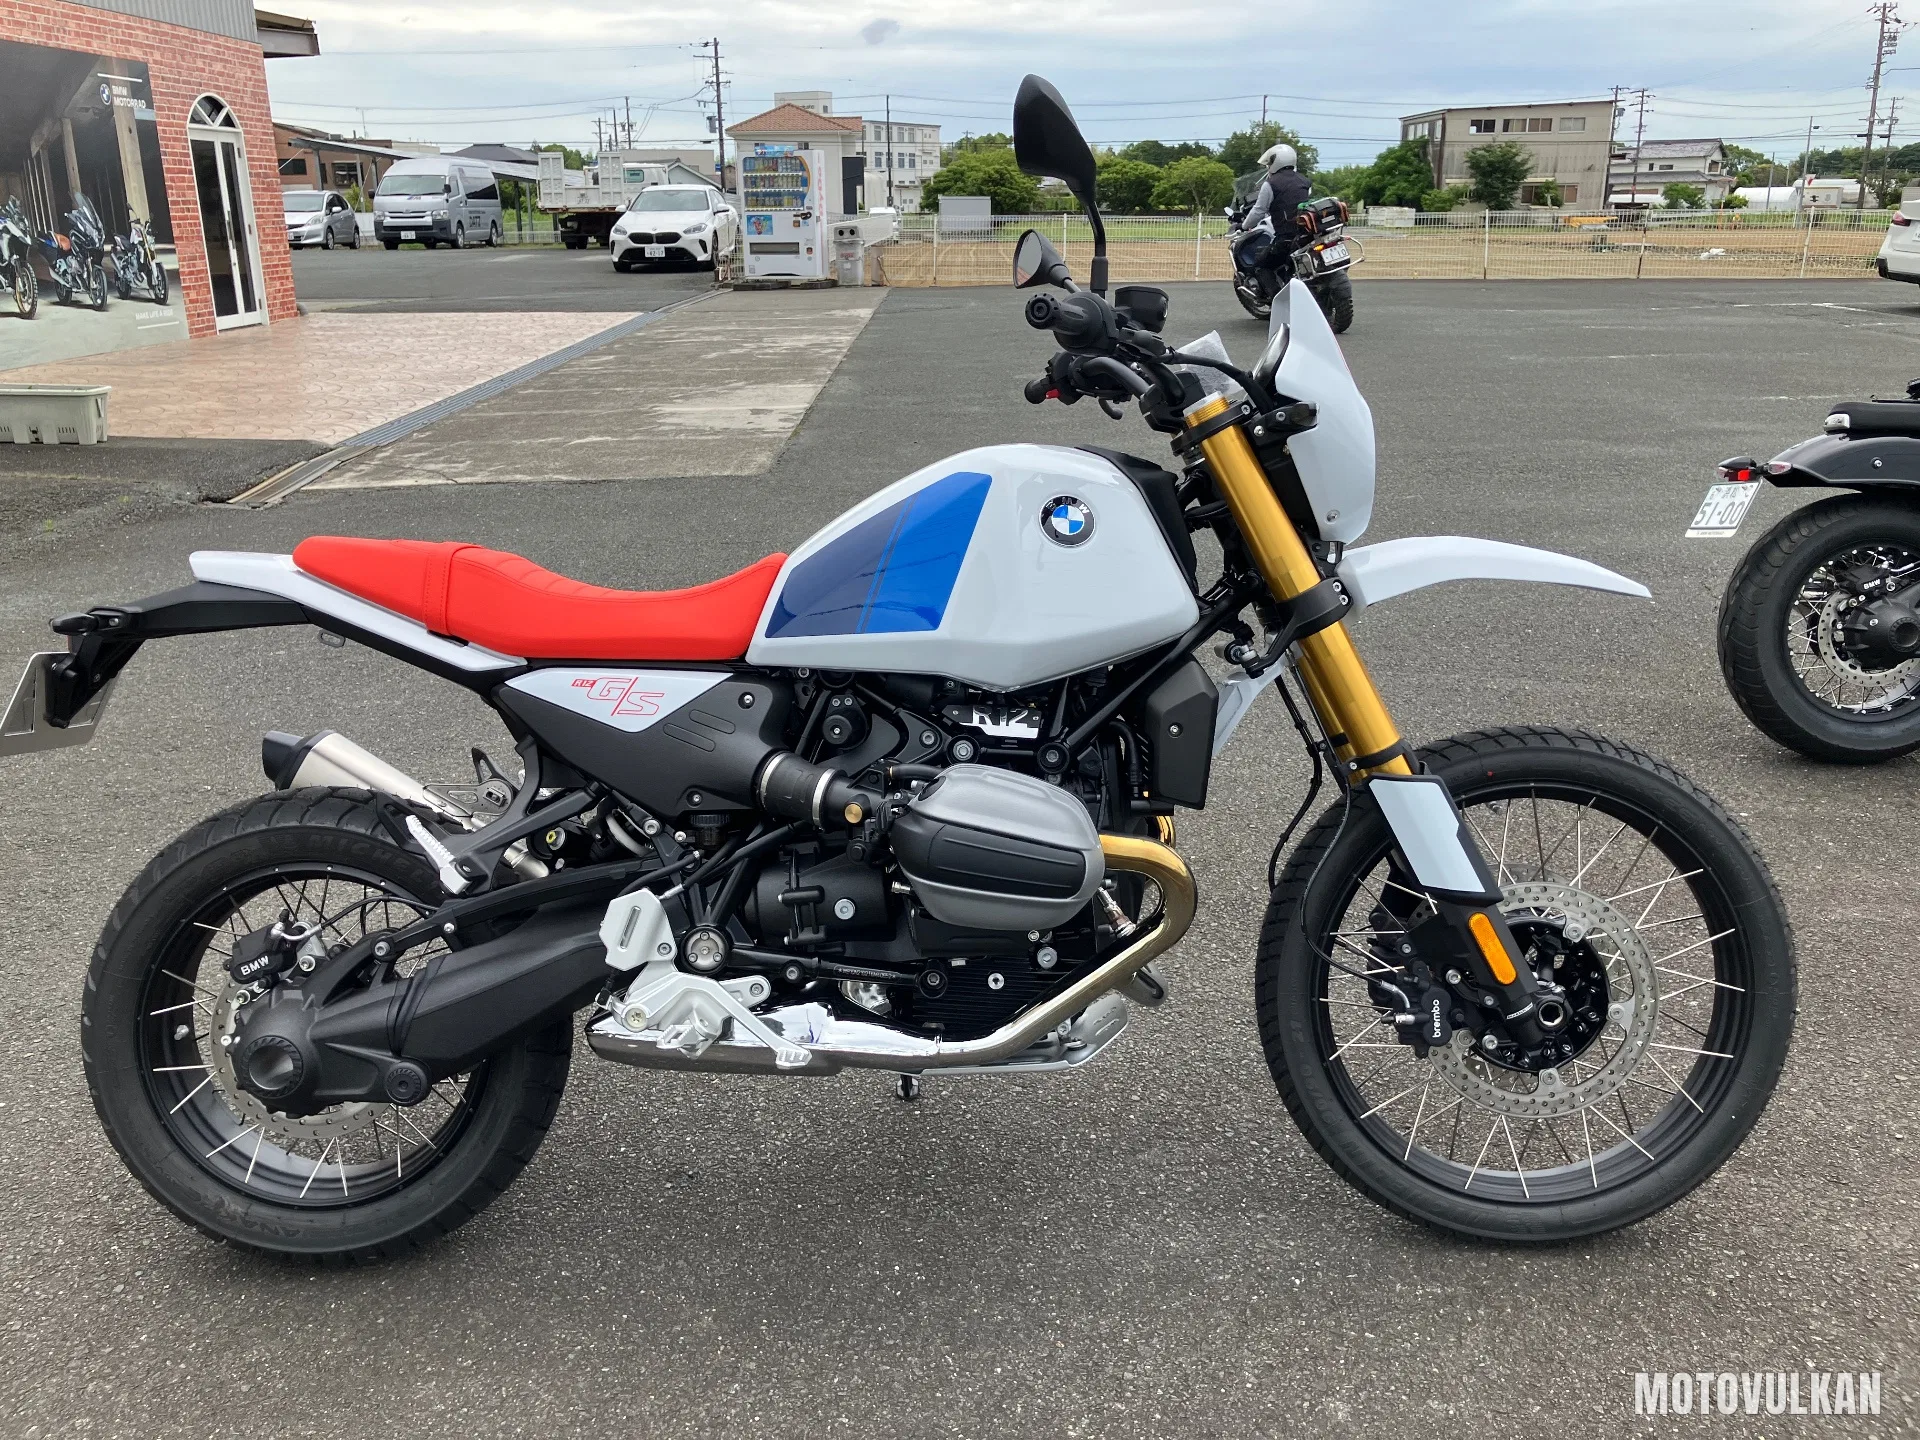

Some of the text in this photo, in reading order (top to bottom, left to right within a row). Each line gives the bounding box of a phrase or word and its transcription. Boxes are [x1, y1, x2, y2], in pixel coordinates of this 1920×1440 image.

[112, 85, 127, 95] BMW
[113, 96, 146, 108] MOTORRAD
[1694, 501, 1746, 526] 51-00
[1863, 578, 1881, 590] BMW
[240, 955, 269, 976] BMW
[1432, 999, 1442, 1038] brembo
